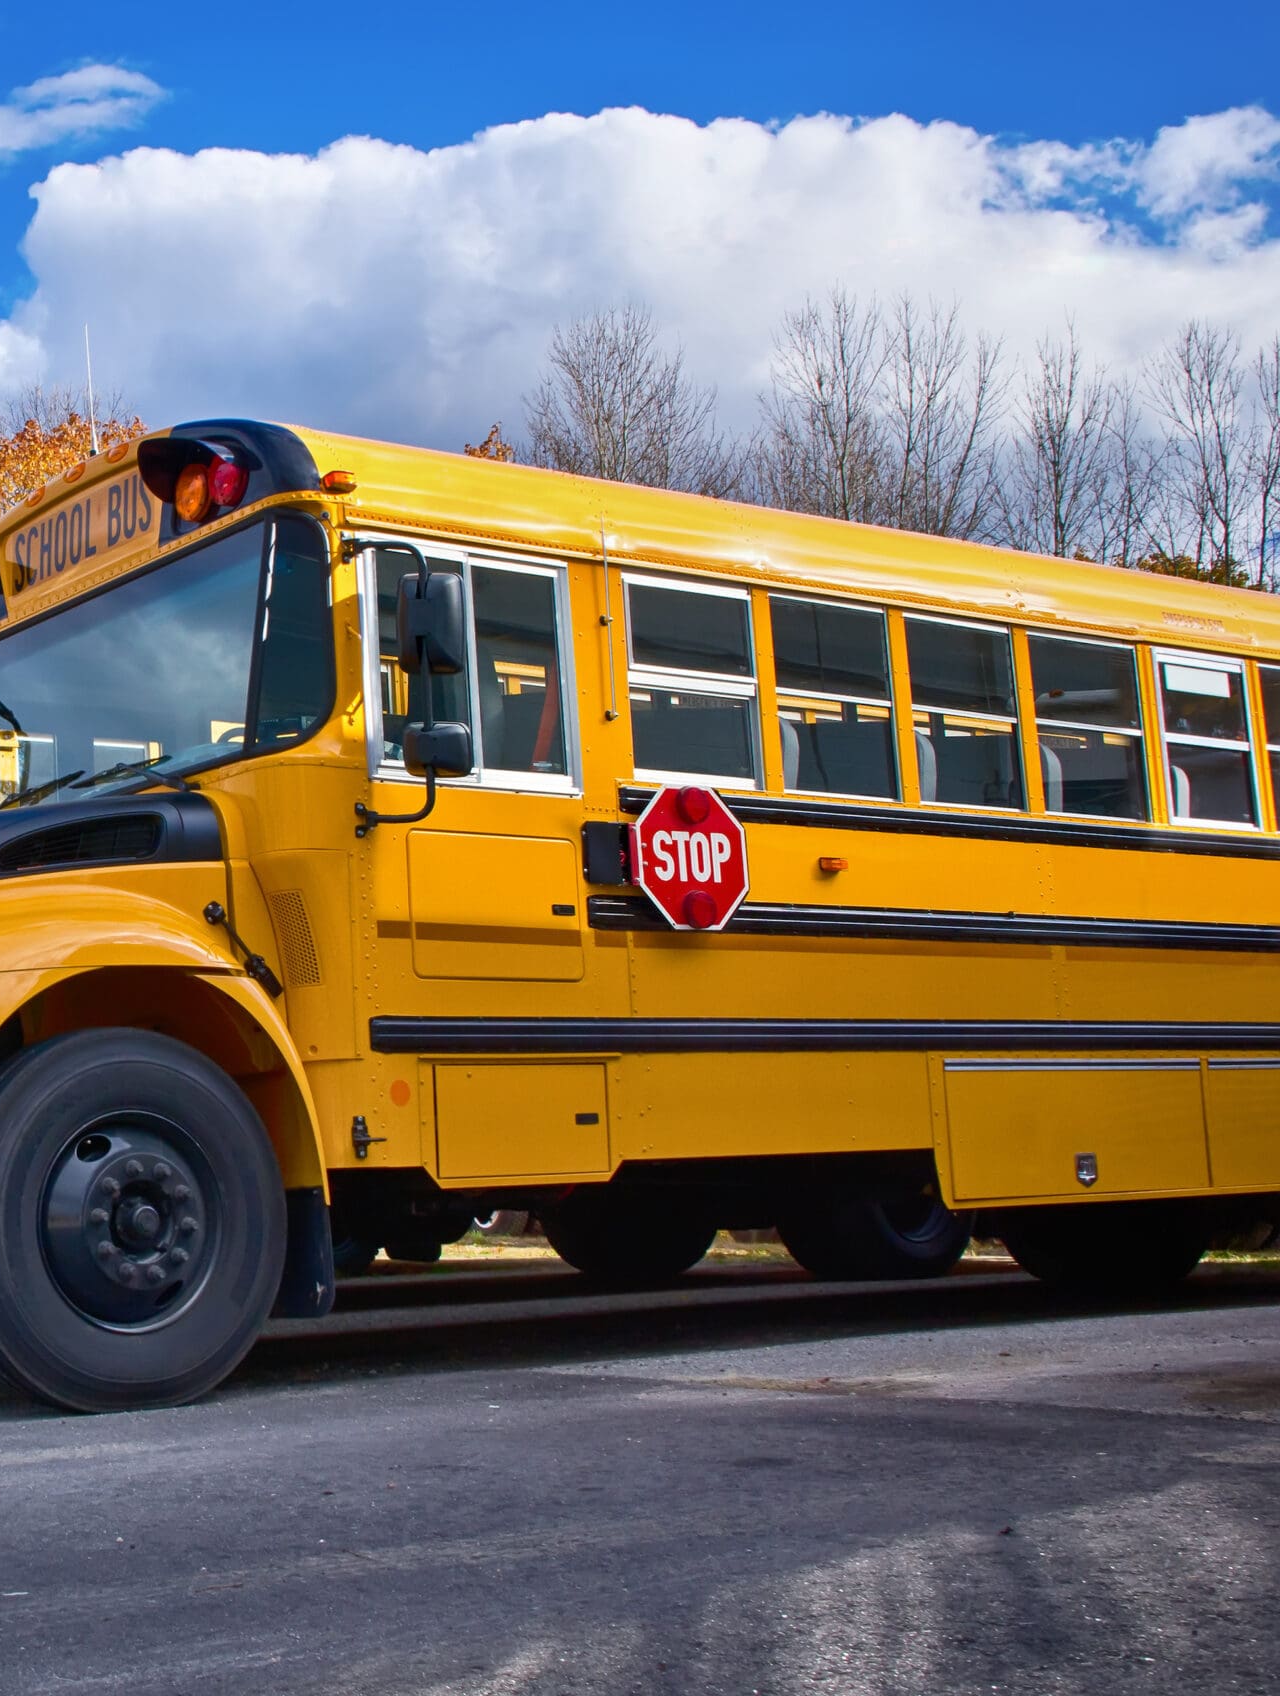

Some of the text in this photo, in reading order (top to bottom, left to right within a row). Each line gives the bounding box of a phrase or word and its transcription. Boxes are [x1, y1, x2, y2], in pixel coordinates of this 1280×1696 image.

[14, 474, 152, 592] SCHOOL BUS
[652, 830, 731, 884] STOP
